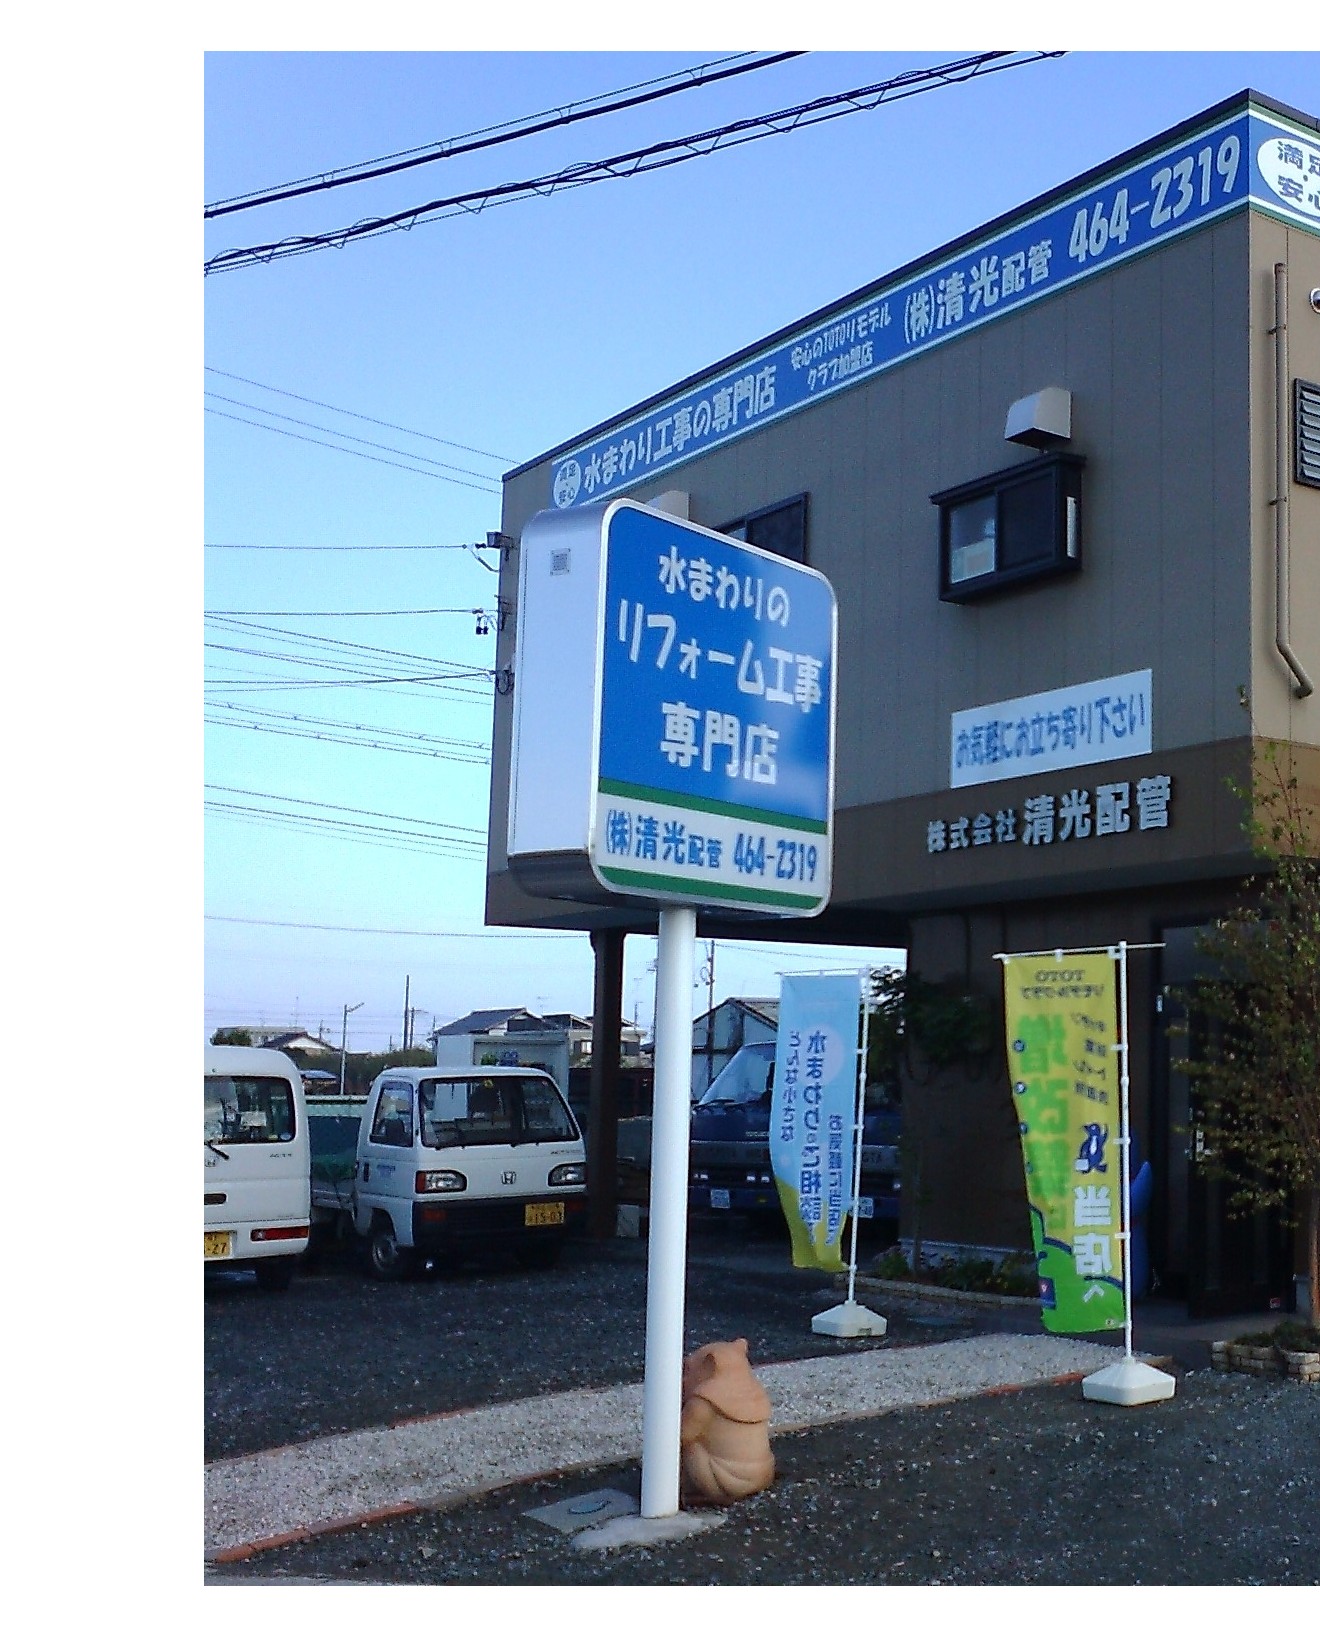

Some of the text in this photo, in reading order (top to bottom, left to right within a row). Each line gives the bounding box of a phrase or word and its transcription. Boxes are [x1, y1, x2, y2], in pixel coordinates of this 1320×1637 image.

[1068, 135, 1240, 263] 464-2319
[791, 302, 892, 371] 安心のTOTOリモデル
[807, 340, 874, 391] クラブ加盟店
[584, 365, 777, 493] 水まわり工事の専門店
[658, 545, 790, 627] 水まわりの
[618, 598, 824, 713] リフォーム工事
[659, 701, 780, 785] 専門店
[956, 693, 1146, 768] お気軽にお立ち寄り下さい
[733, 832, 818, 881] 464-2319
